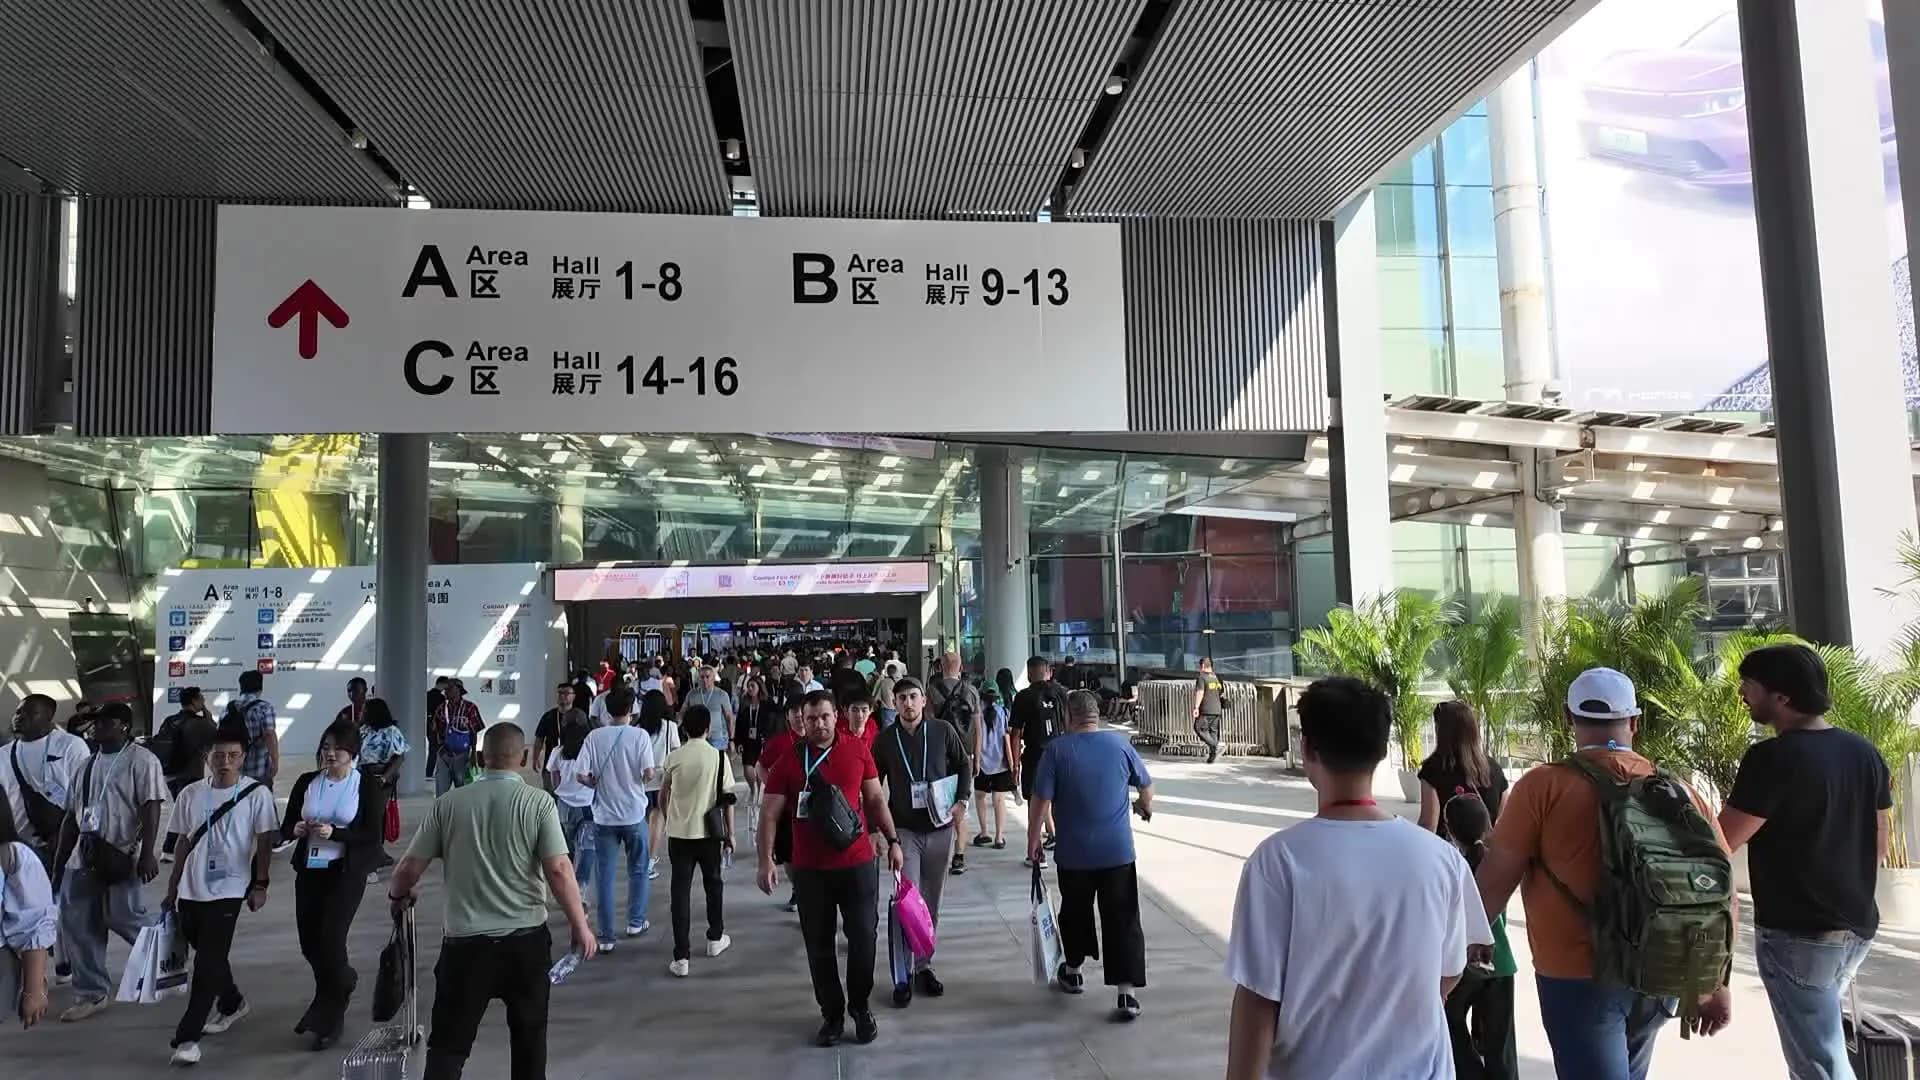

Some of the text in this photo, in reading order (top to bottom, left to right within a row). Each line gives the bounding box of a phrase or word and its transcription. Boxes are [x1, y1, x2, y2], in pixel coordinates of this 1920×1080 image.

[401, 245, 683, 301] A Area Hall 1-8
[470, 268, 601, 300] 区 展厅
[792, 252, 1069, 306] B Area Hall 9-13
[852, 276, 970, 306] 区 展厅
[403, 339, 739, 397] C Area Hall 14-16
[470, 365, 602, 396] 区 展厅
[203, 583, 220, 601] A
[262, 586, 283, 599] 1-8
[223, 590, 233, 601] 区
[443, 578, 452, 588] A
